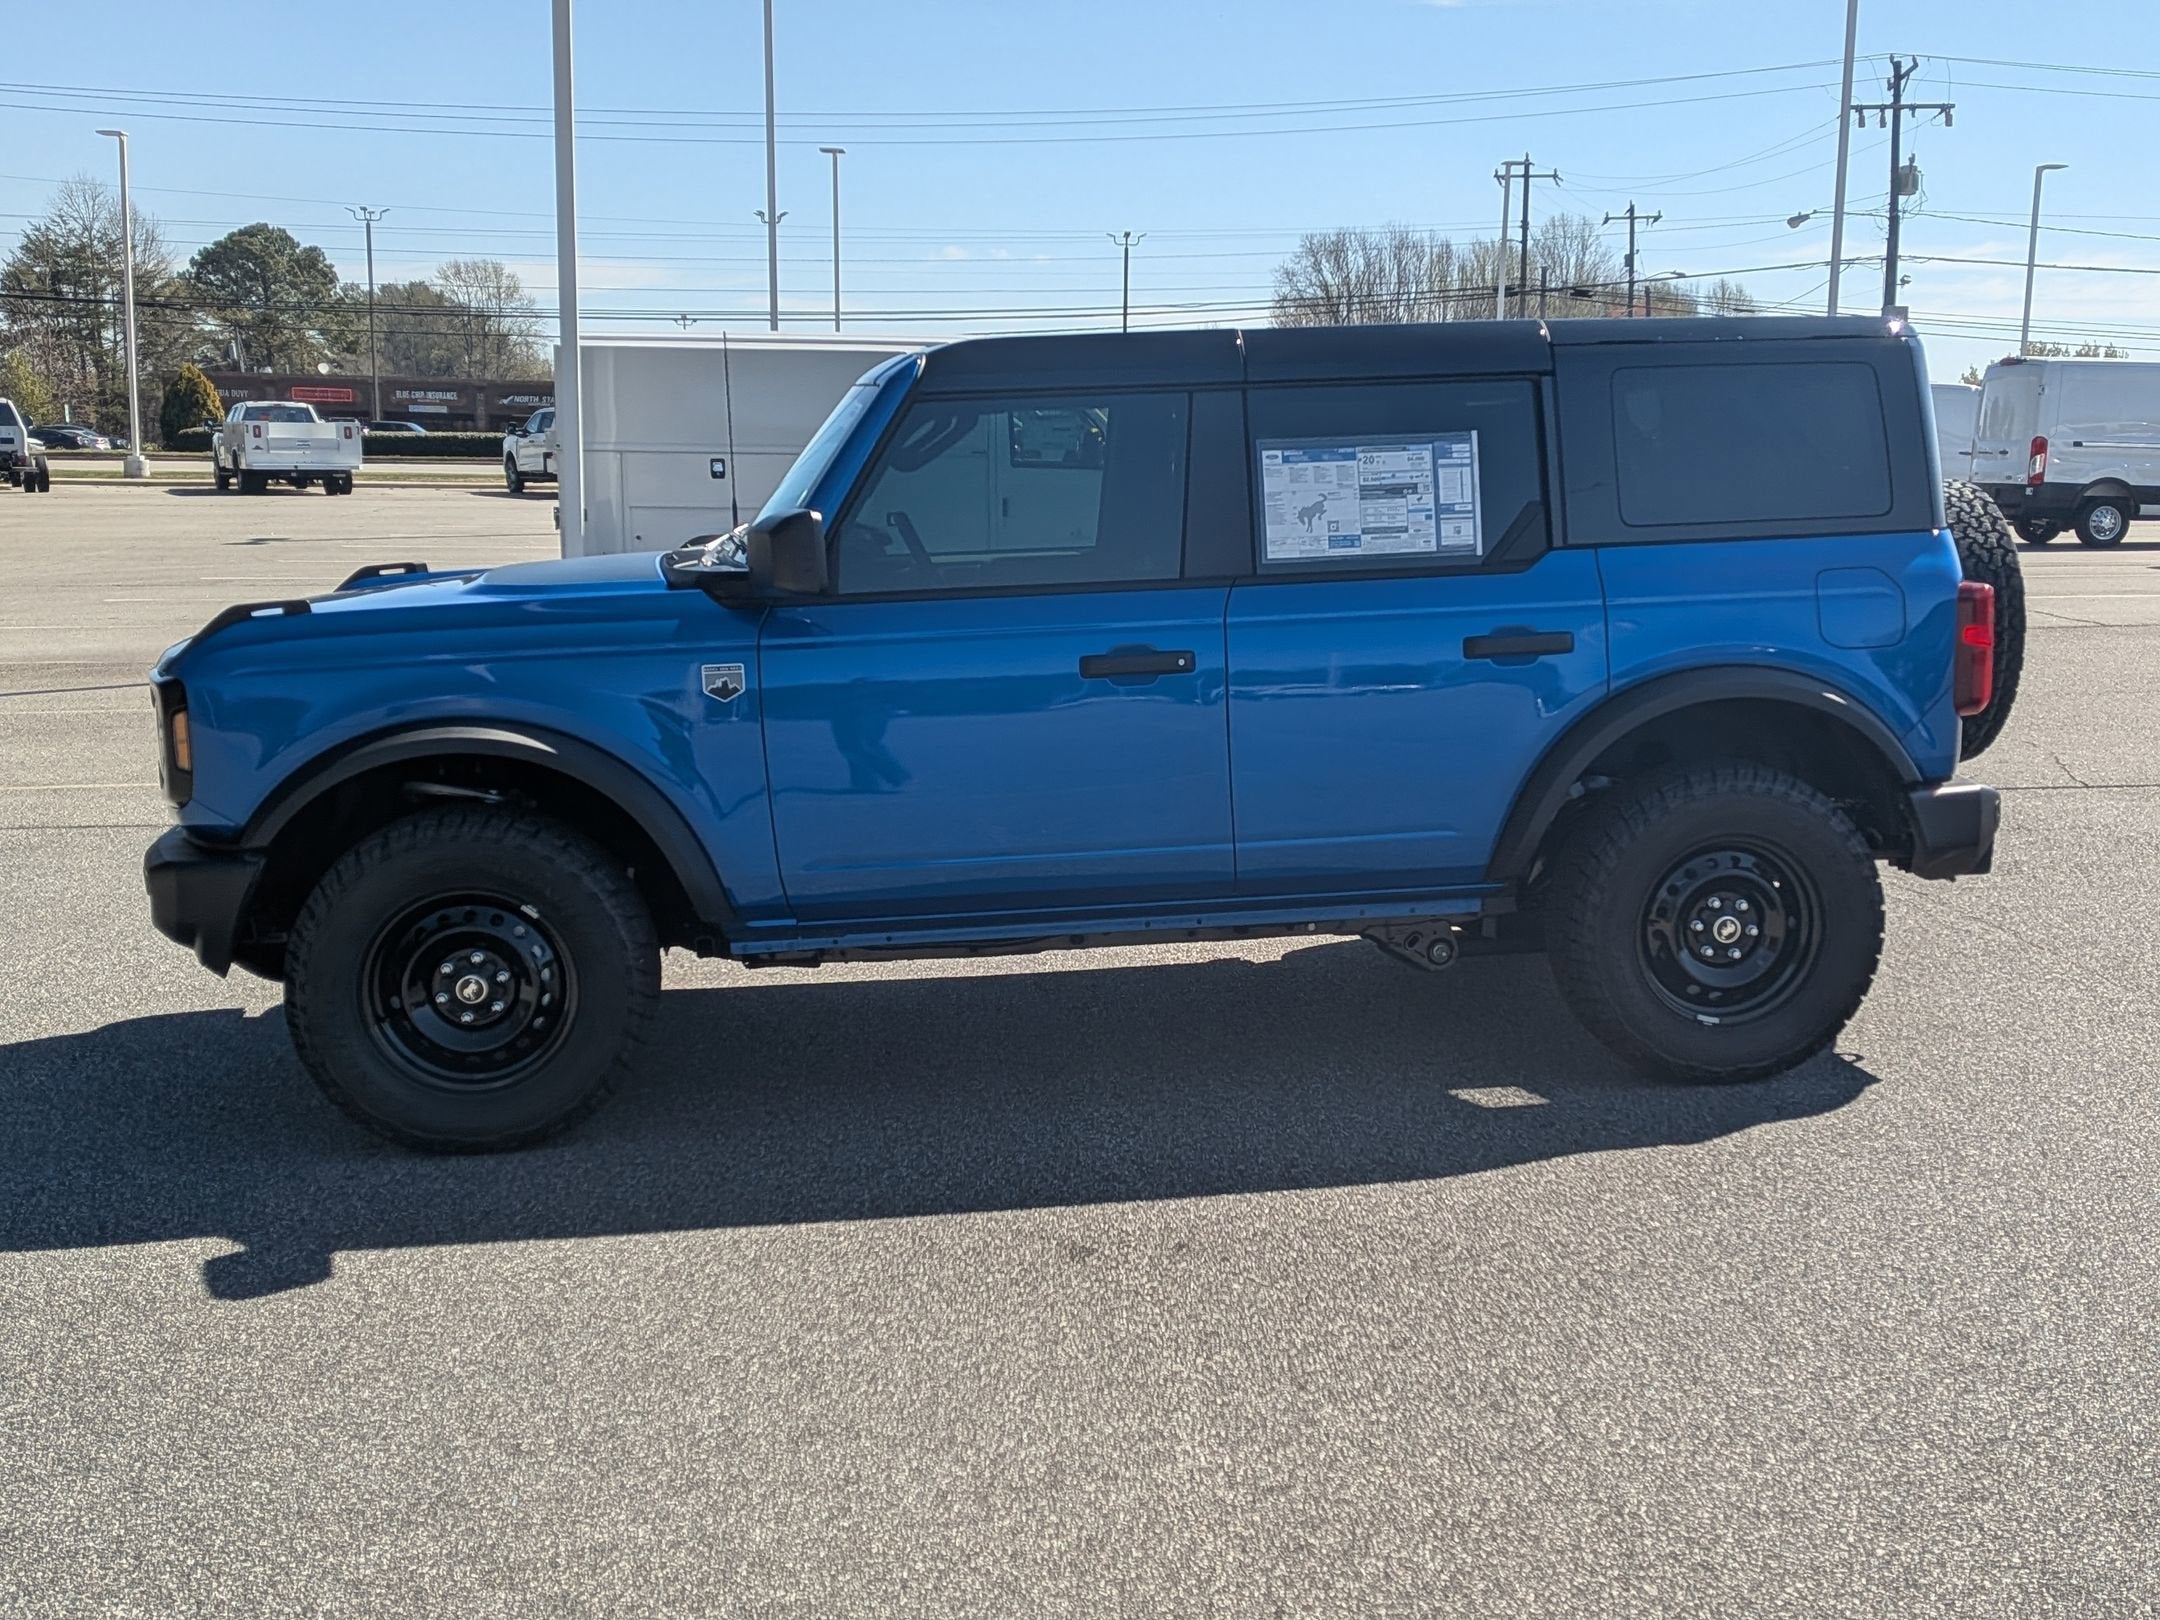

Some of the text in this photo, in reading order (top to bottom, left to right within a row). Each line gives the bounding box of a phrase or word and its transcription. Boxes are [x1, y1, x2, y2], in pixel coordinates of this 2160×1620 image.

[426, 391, 458, 400] INSURANCE
[514, 395, 539, 403] NORTH
[1362, 455, 1374, 464] 20
